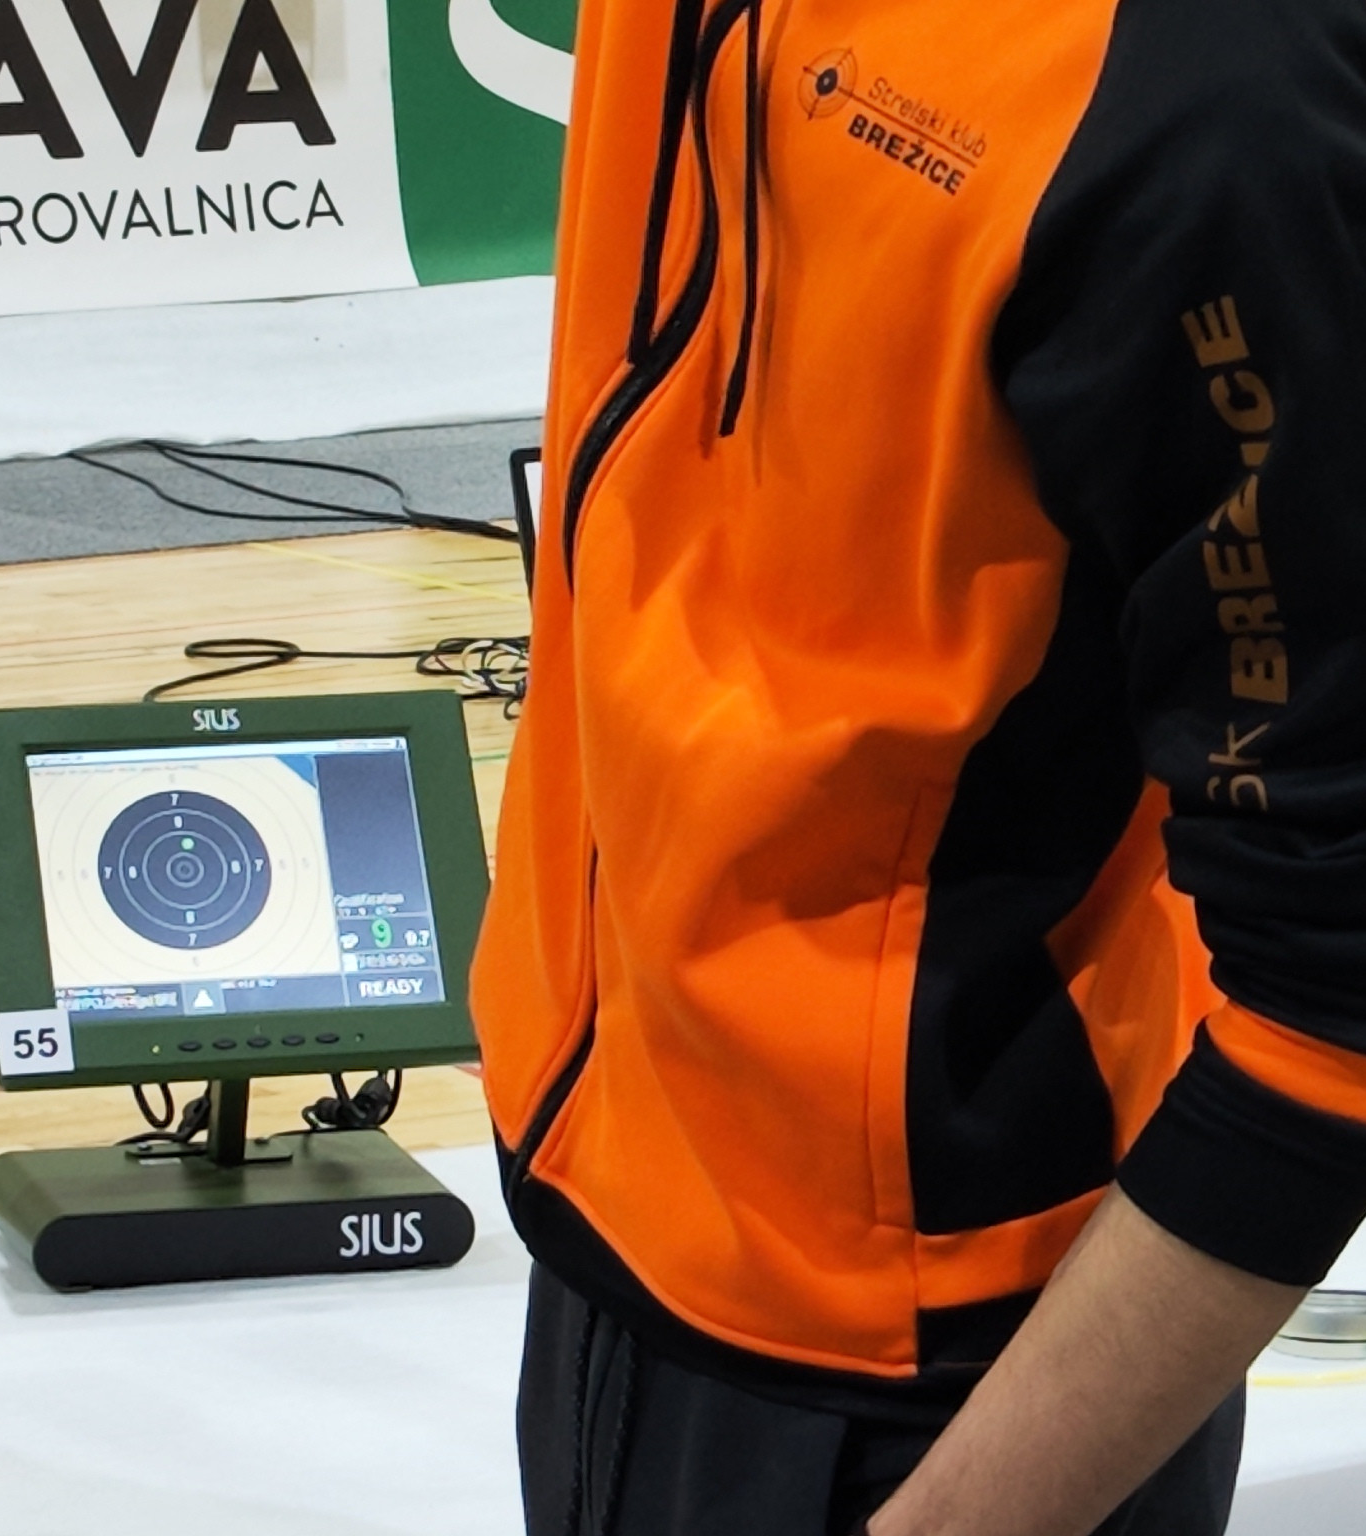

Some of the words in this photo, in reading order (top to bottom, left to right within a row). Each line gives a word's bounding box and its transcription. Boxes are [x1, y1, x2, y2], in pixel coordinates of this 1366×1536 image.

[868, 76, 947, 138] Strelski
[950, 116, 987, 159] klub
[848, 113, 967, 196] BREŽICE
[192, 708, 241, 732] SIUS
[371, 918, 393, 948] 9
[359, 977, 424, 998] READY
[12, 1026, 59, 1059] 55
[339, 1211, 424, 1257] SIUS
